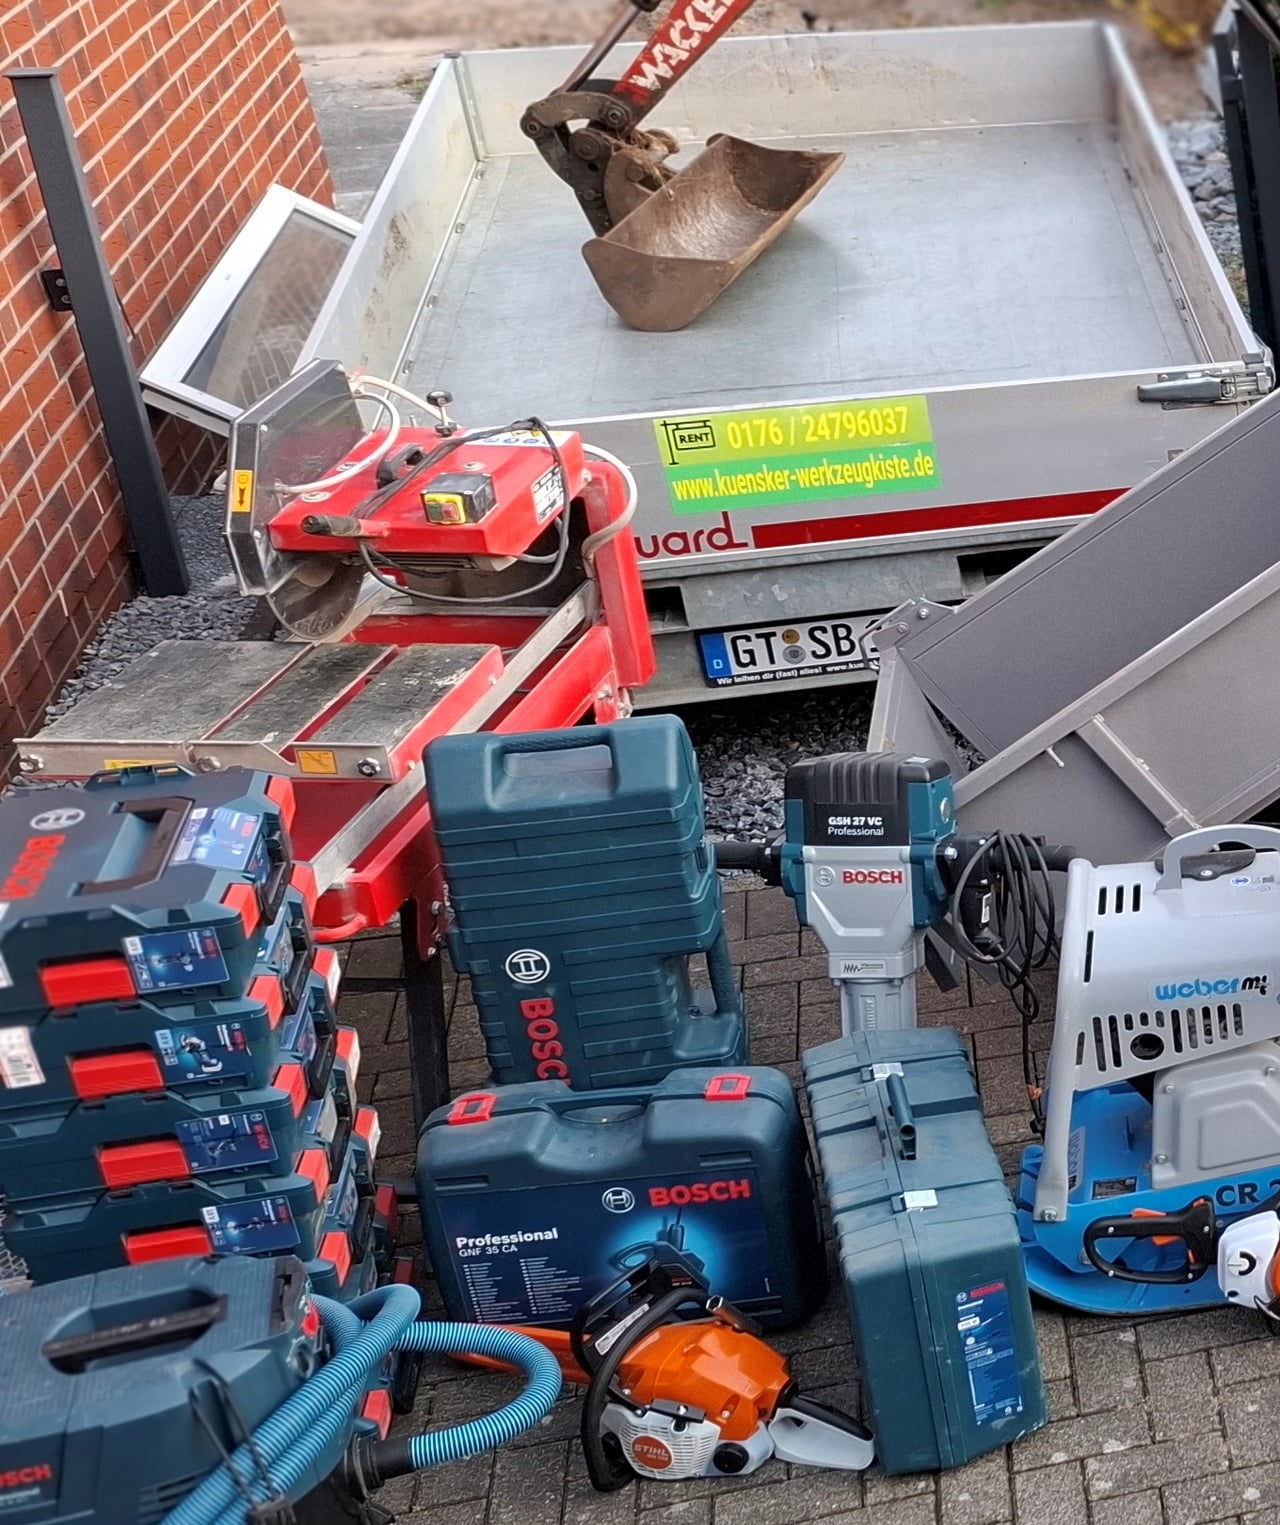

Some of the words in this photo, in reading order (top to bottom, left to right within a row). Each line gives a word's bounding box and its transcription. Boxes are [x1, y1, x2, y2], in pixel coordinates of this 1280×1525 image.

[628, 0, 735, 91] WACKE
[679, 432, 711, 444] RENT
[726, 418, 783, 449] 0176
[802, 406, 908, 442] 24796037
[672, 449, 934, 501] www.kuensker-werkzeugkiste.de
[634, 511, 748, 559] uard
[713, 659, 723, 670] D
[730, 631, 777, 668] GT
[807, 623, 857, 660] SB
[716, 677, 732, 685] Wir
[762, 671, 774, 680] dir
[800, 666, 822, 676] alles!
[828, 816, 851, 826] GSH
[852, 817, 865, 826] 27
[867, 817, 883, 826] VC
[828, 827, 884, 836] Professional
[842, 870, 903, 884] BOSCH
[521, 997, 572, 1086] BOSC
[648, 1179, 751, 1208] BOSCH
[1216, 1182, 1260, 1206] CR
[455, 1227, 559, 1249] Professional
[459, 1248, 483, 1258] GNF
[484, 1246, 500, 1256] 35
[501, 1244, 518, 1254] CA
[634, 1444, 669, 1457] STIHL
